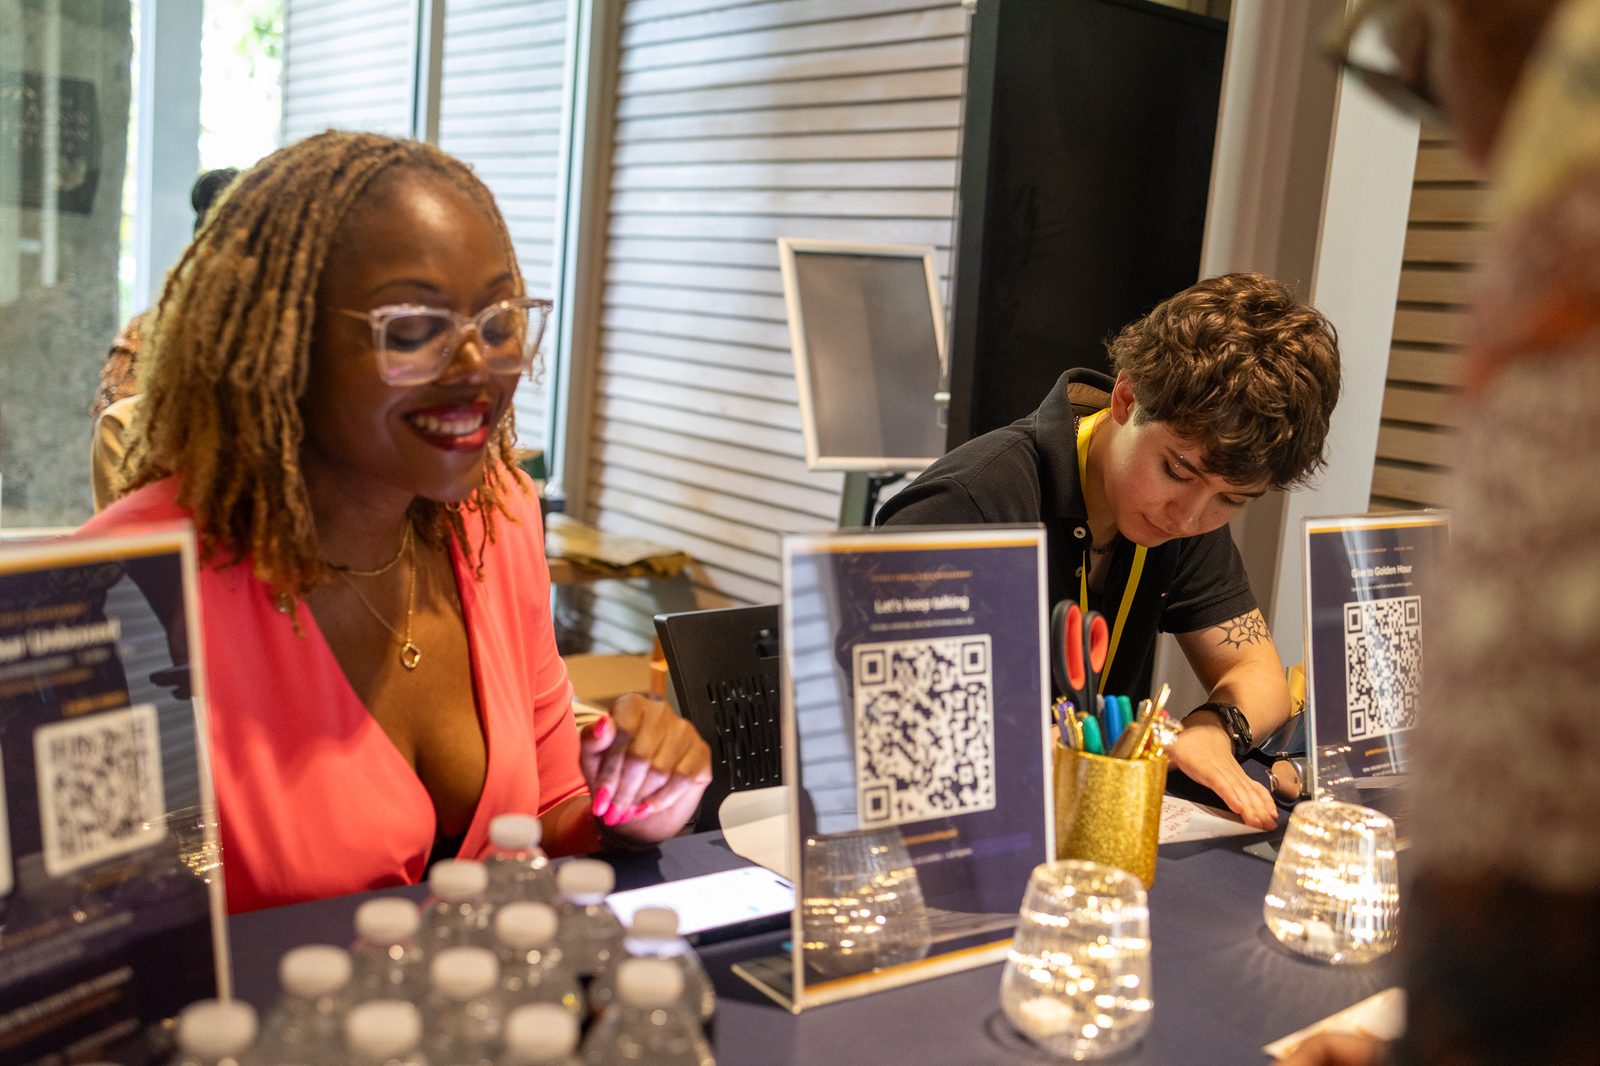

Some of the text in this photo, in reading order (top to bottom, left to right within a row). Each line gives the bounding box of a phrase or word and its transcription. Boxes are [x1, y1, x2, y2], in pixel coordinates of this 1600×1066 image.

[1375, 565, 1396, 576] Golden
[1397, 564, 1412, 573] Hour
[874, 594, 970, 614] Let's keep talking
